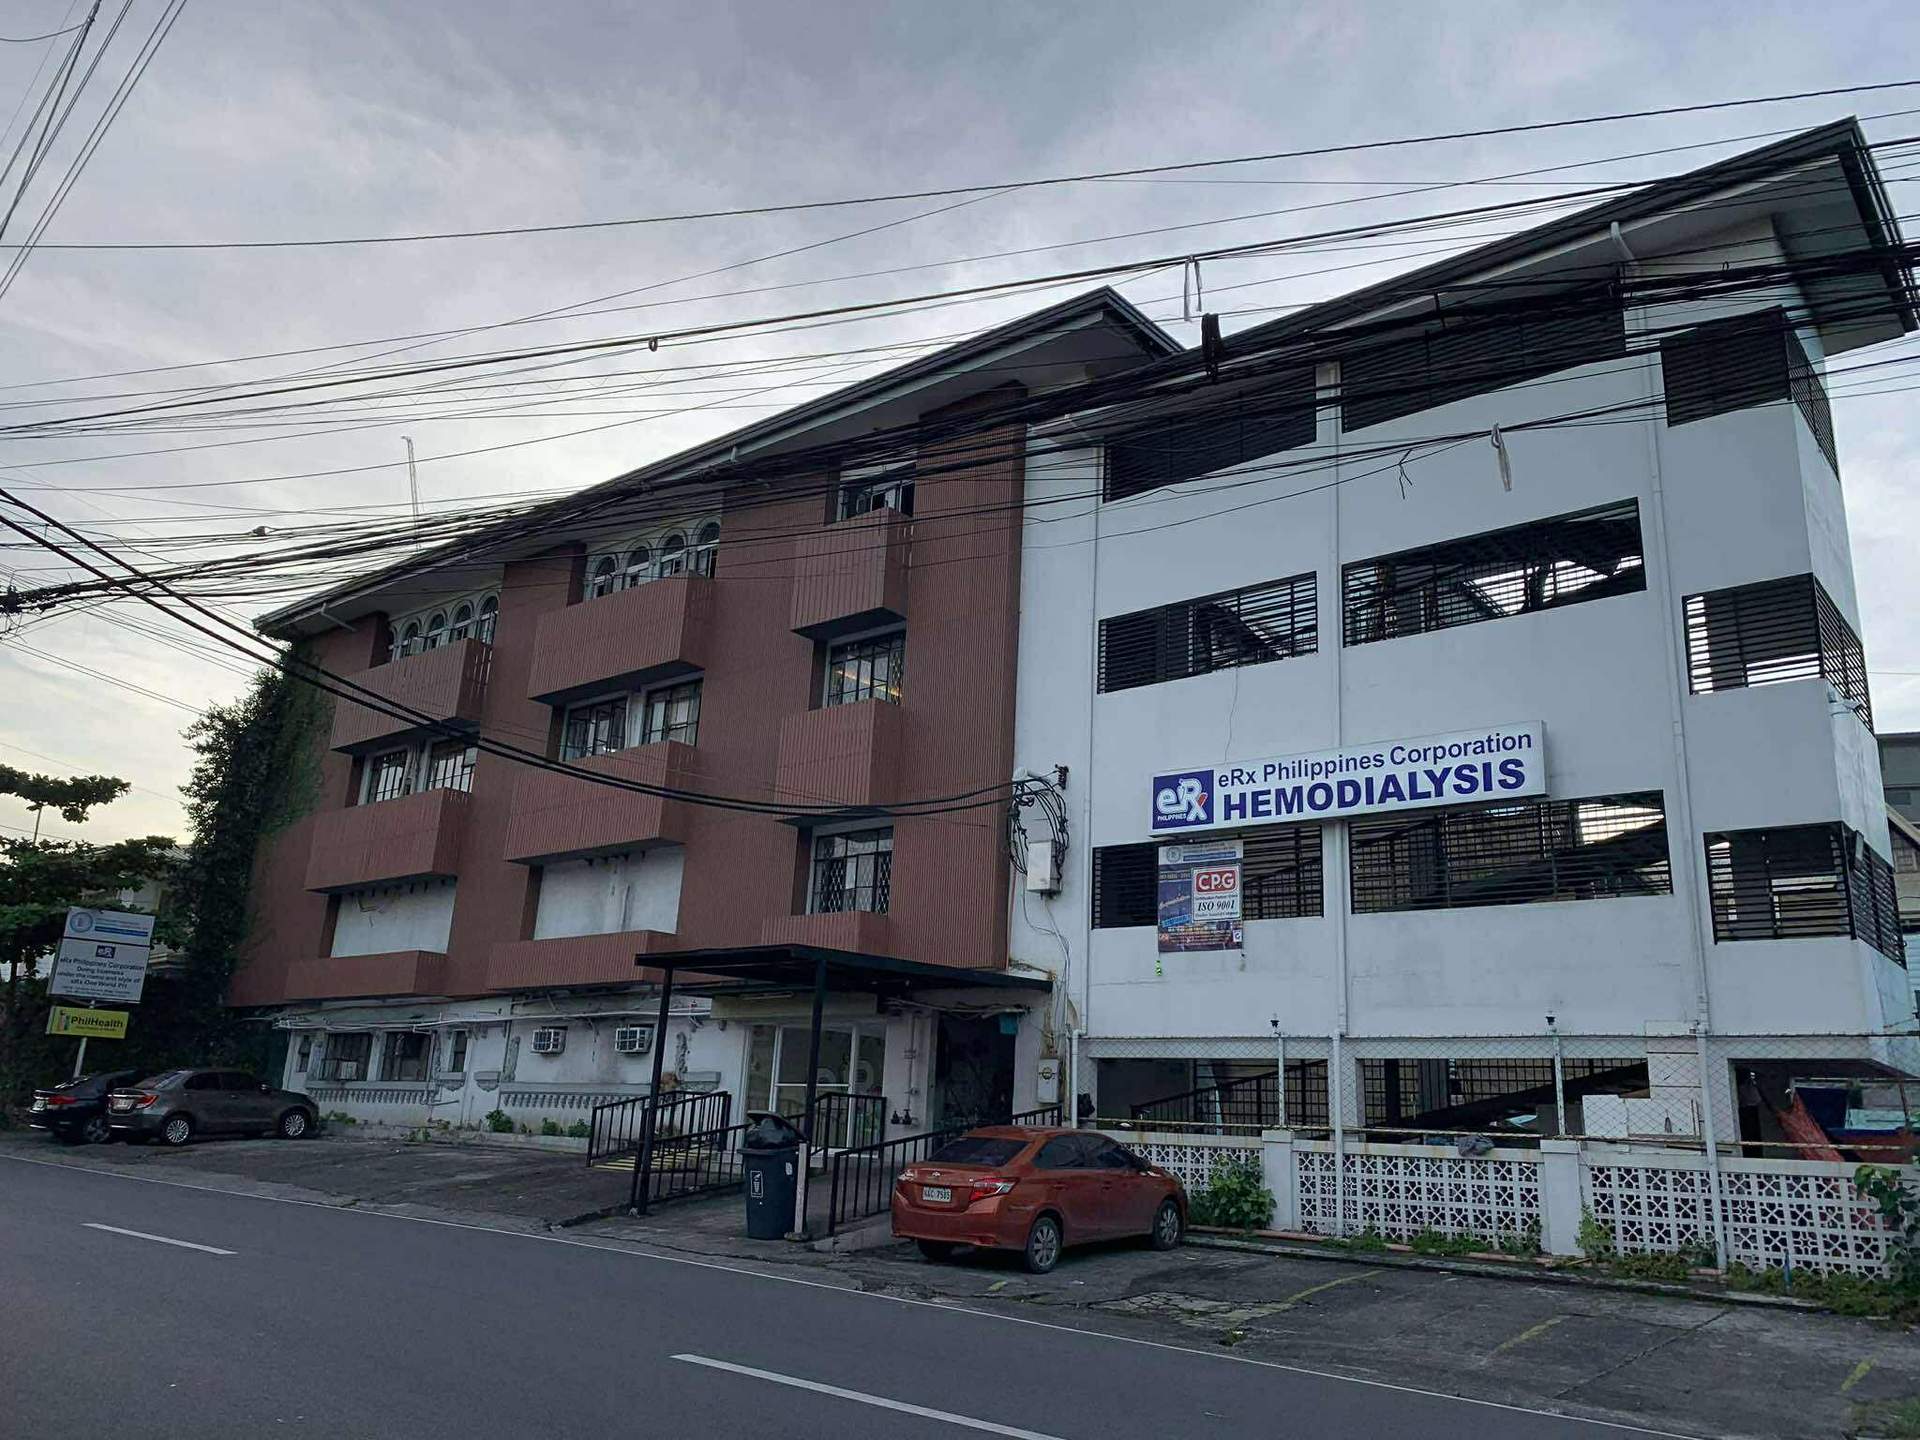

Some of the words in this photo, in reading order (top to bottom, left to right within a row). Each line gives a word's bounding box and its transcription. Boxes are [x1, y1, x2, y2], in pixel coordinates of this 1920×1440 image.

[1218, 768, 1257, 789] eRx
[1263, 754, 1386, 786] Philippines
[1390, 732, 1533, 768] Corporation
[1223, 758, 1526, 821] HEMODIALYSIS
[1198, 902, 1214, 911] ISO
[1216, 900, 1235, 910] 9001
[71, 1016, 123, 1028] PhilHealth
